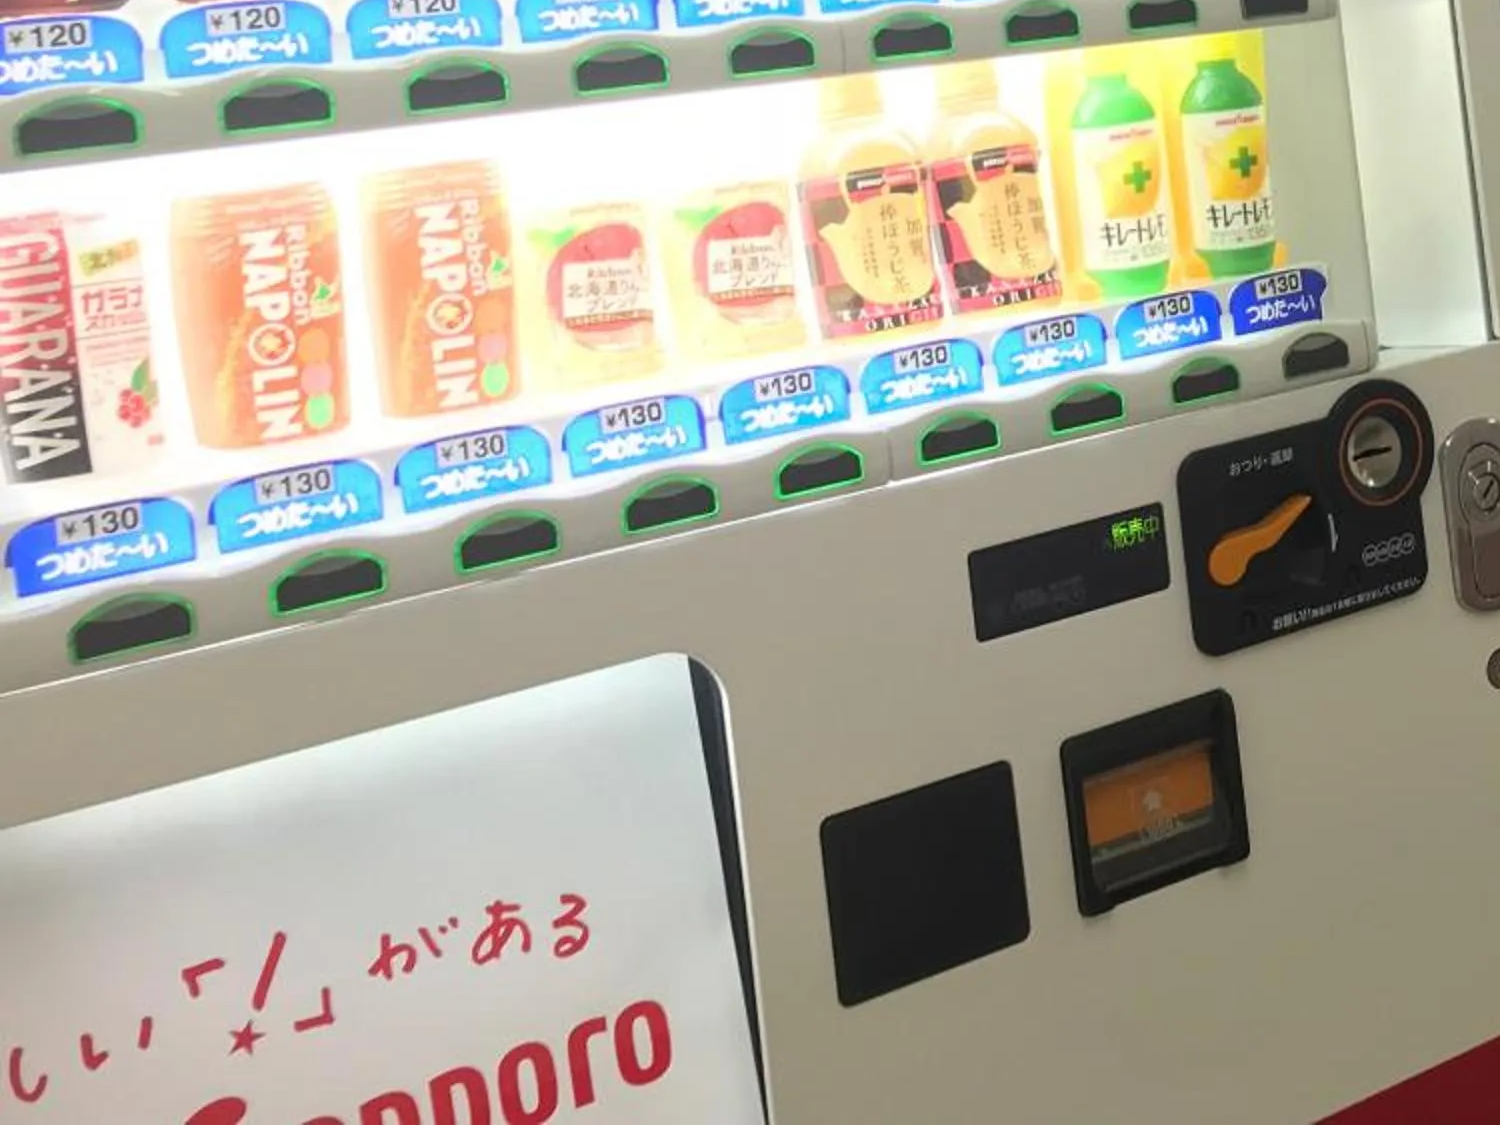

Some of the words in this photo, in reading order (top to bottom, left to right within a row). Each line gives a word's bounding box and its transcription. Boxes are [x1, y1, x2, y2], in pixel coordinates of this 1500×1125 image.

[210, 6, 282, 31] ¥120
[9, 22, 88, 49] ¥120
[456, 196, 489, 296] Ribbon
[286, 224, 314, 326] Ribbon
[1259, 274, 1300, 295] ¥130
[414, 201, 479, 409] NAPOLIN
[1149, 295, 1193, 318] ¥130
[237, 227, 305, 444] NAPOLIN
[1029, 319, 1076, 343] ¥130
[898, 346, 949, 368] ¥130
[758, 372, 812, 397] ¥130
[605, 402, 663, 430] ¥130
[441, 433, 505, 463] ¥130
[261, 468, 331, 501] ¥130
[61, 506, 139, 541] ¥130
[1111, 515, 1160, 551] 販売中
